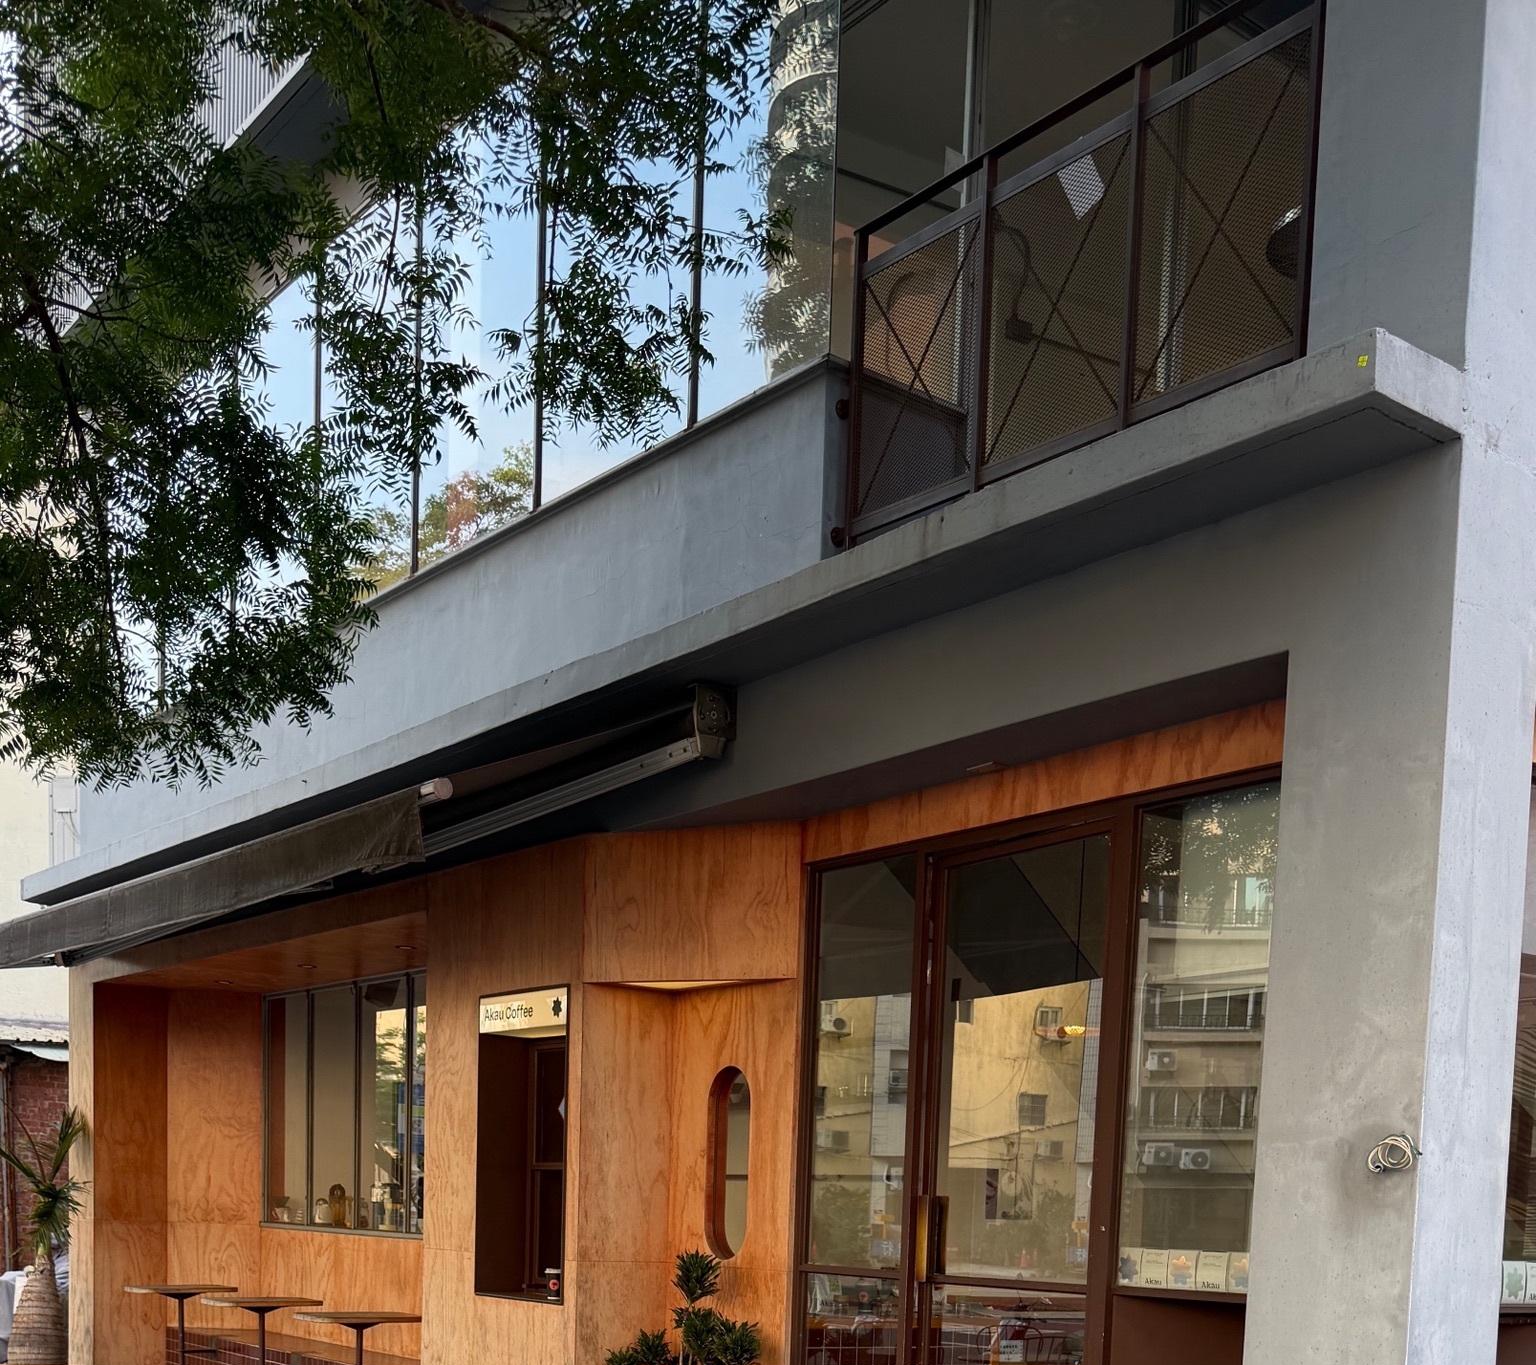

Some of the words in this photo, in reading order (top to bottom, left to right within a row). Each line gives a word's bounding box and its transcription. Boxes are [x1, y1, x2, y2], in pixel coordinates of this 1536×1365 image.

[484, 1008, 504, 1021] Akau
[505, 1005, 533, 1020] Coffee
[1145, 1277, 1162, 1286] Akau
[1201, 1281, 1220, 1289] Akau
